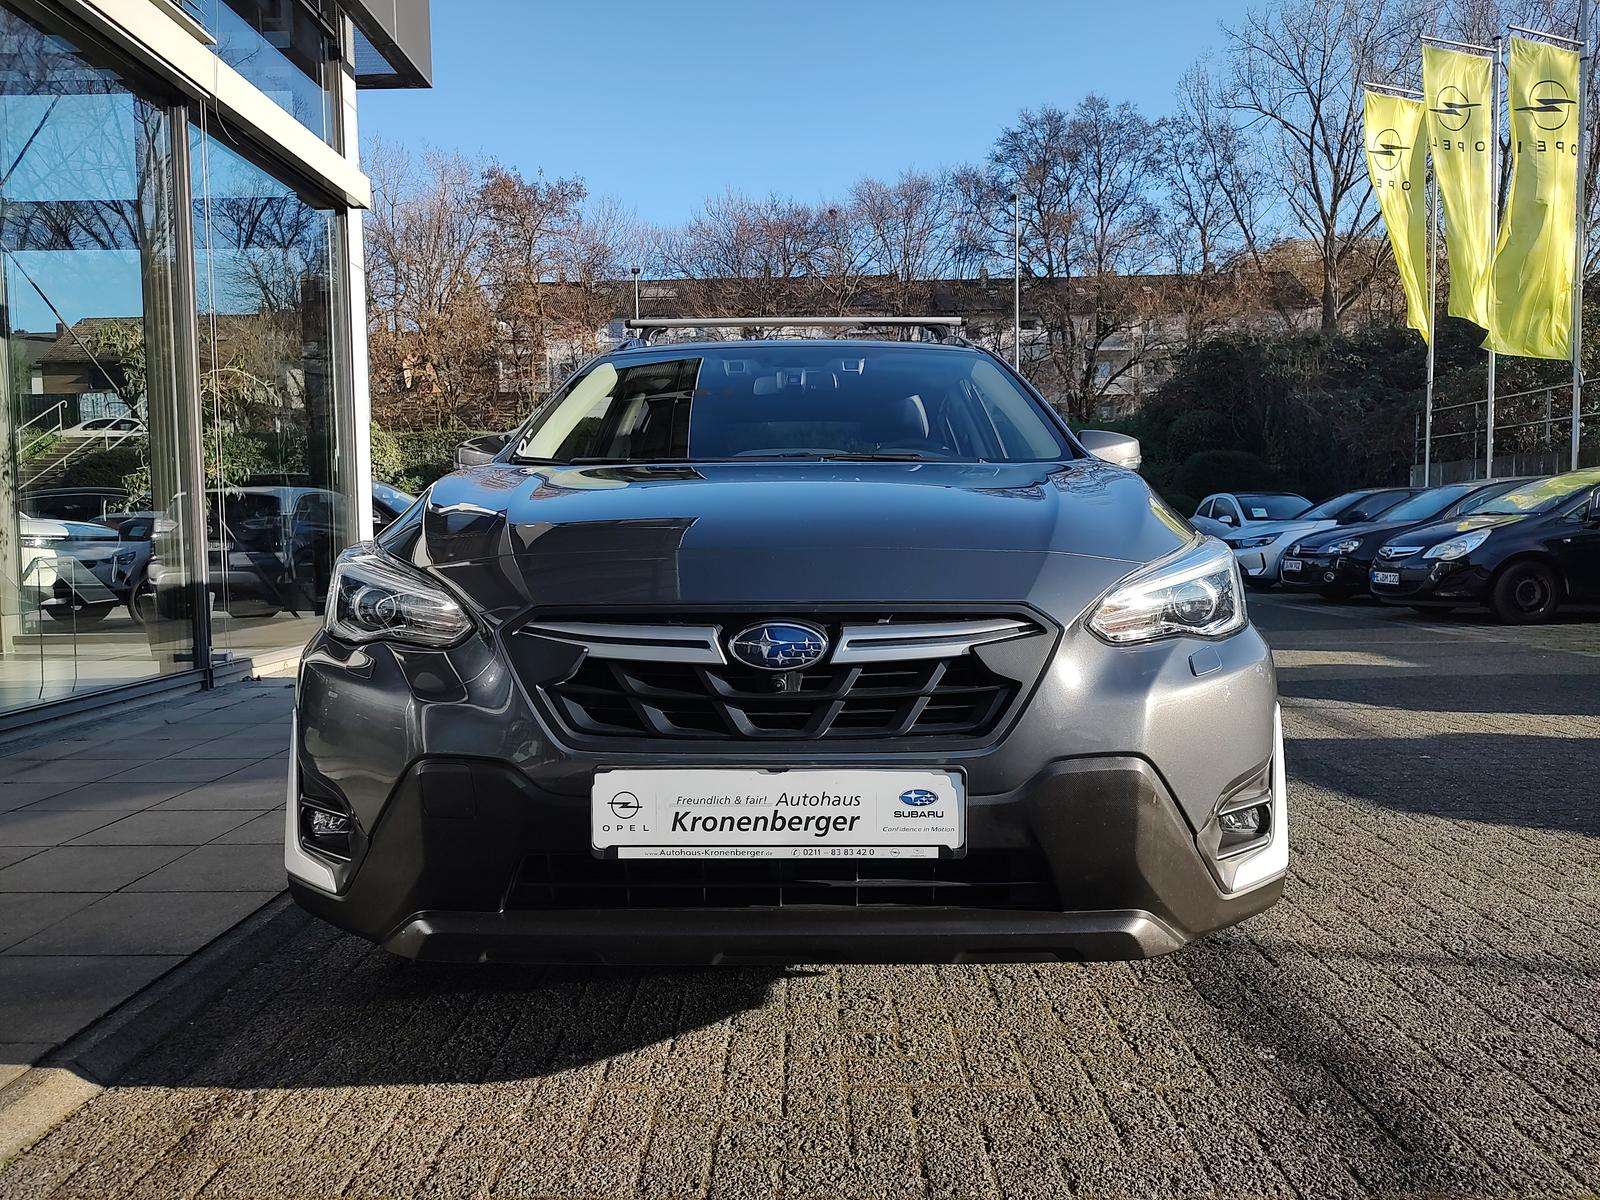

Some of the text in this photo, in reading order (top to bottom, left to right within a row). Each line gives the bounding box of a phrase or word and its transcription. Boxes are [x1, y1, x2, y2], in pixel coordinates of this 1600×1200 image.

[676, 791, 861, 807] Freundlich & fair! Autohaus
[893, 810, 944, 818] SUBARU
[671, 809, 861, 837] Kronenberger
[602, 824, 650, 832] OPEL
[803, 848, 821, 856] 0211
[831, 848, 842, 856] 83
[844, 848, 854, 856] 83
[856, 848, 867, 856] 42
[869, 848, 875, 856] 0
